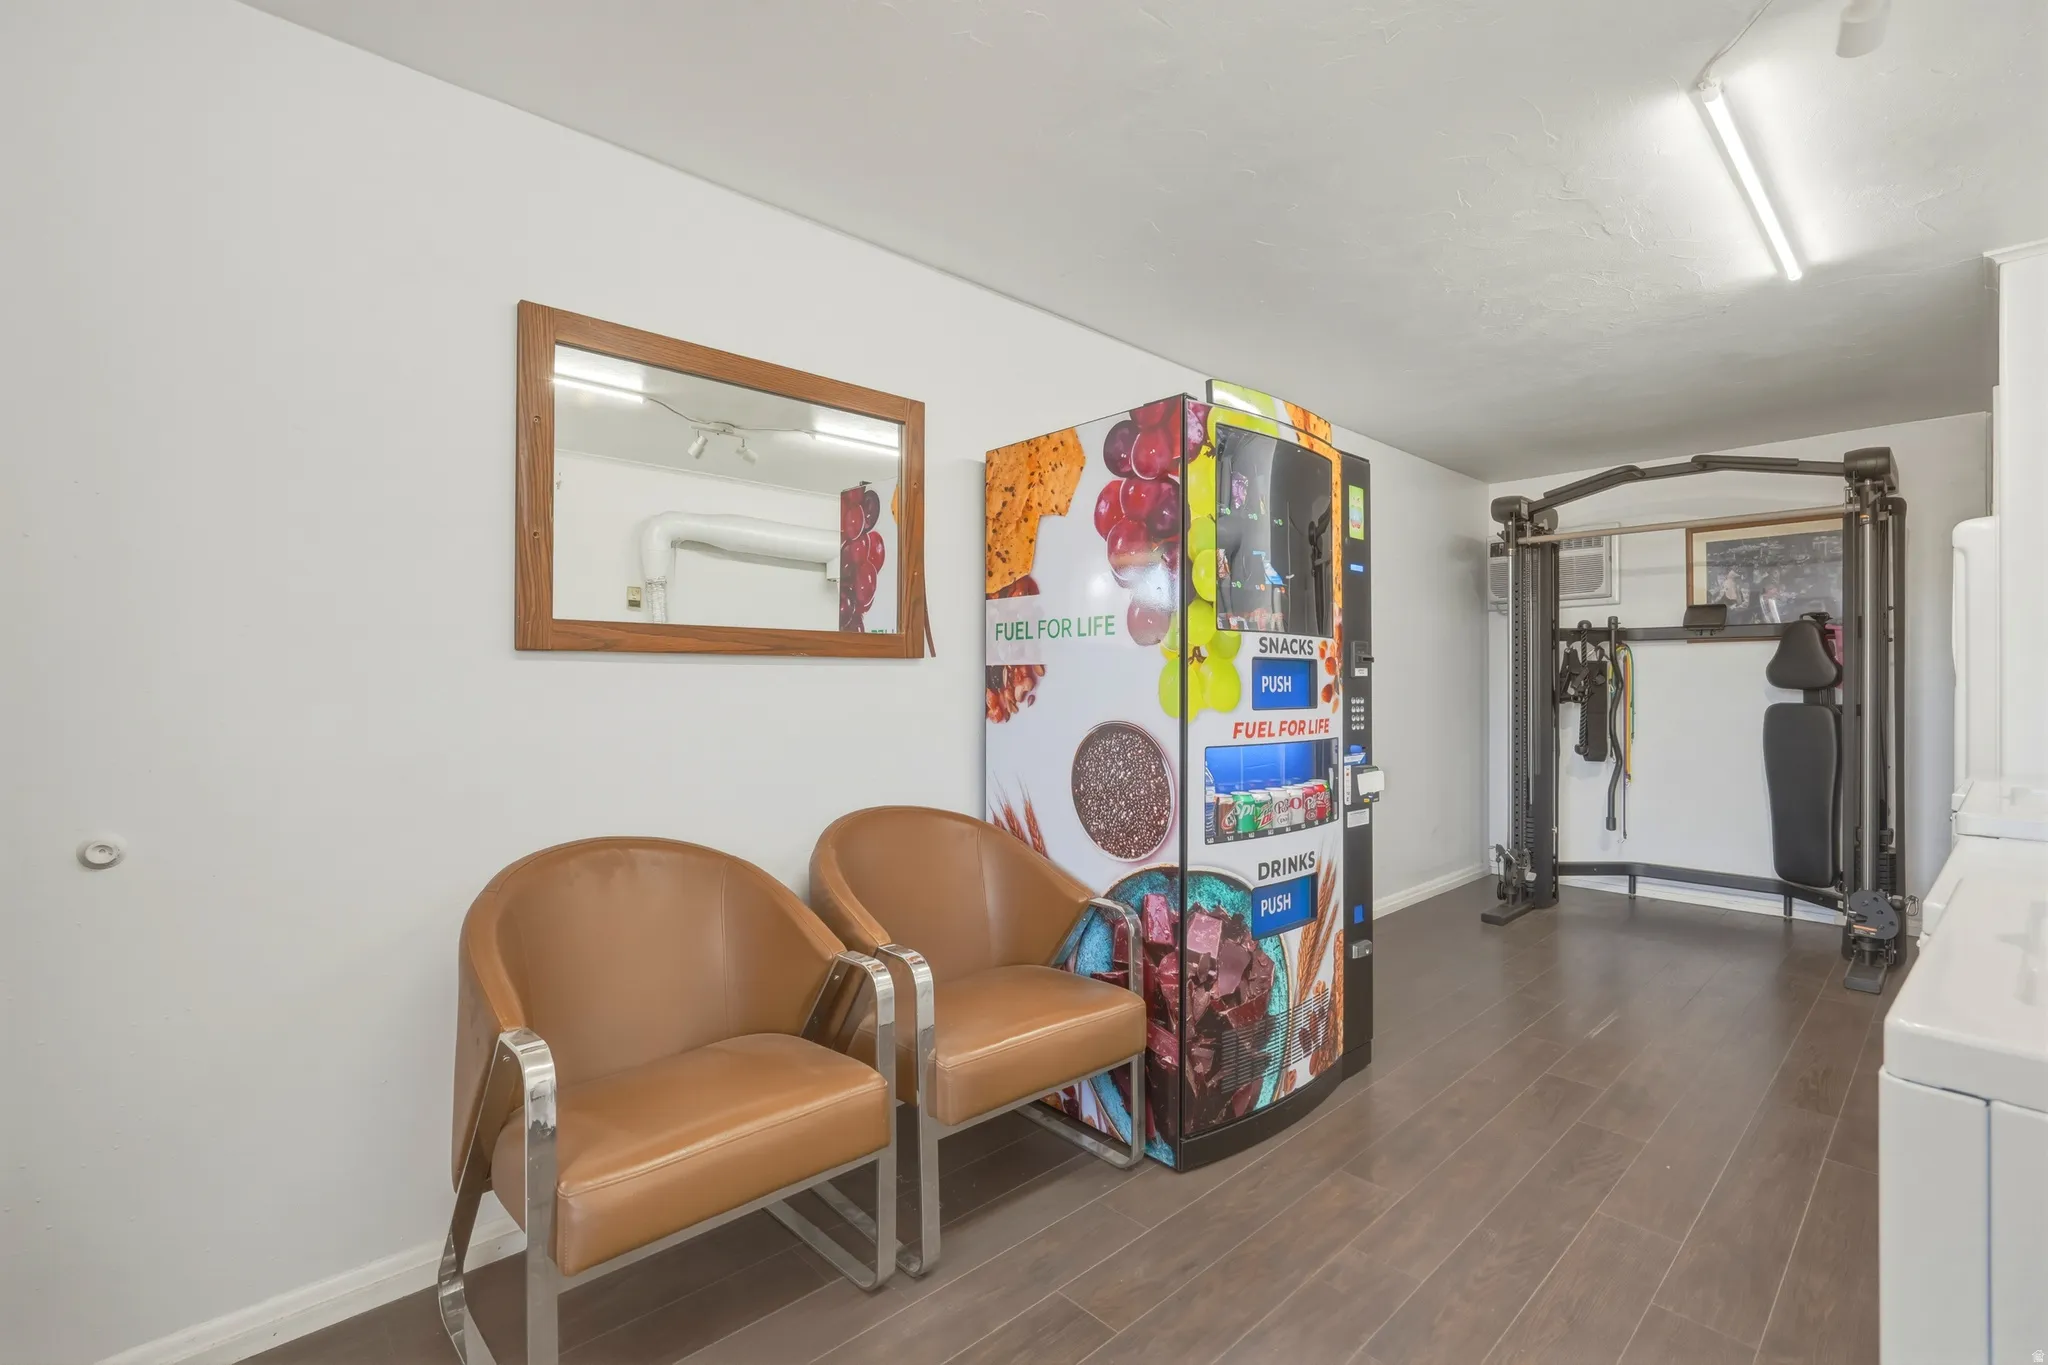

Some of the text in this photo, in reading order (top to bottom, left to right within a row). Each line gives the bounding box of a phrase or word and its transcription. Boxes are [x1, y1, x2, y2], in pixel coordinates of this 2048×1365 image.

[996, 615, 1115, 641] FUEL FOR LIFE
[1258, 636, 1314, 656] SNACKS
[1261, 675, 1292, 693] PUSH
[1232, 718, 1330, 739] FUEL FOR LIFE
[1257, 850, 1316, 881] DRINKS
[1260, 892, 1292, 917] PUSH
